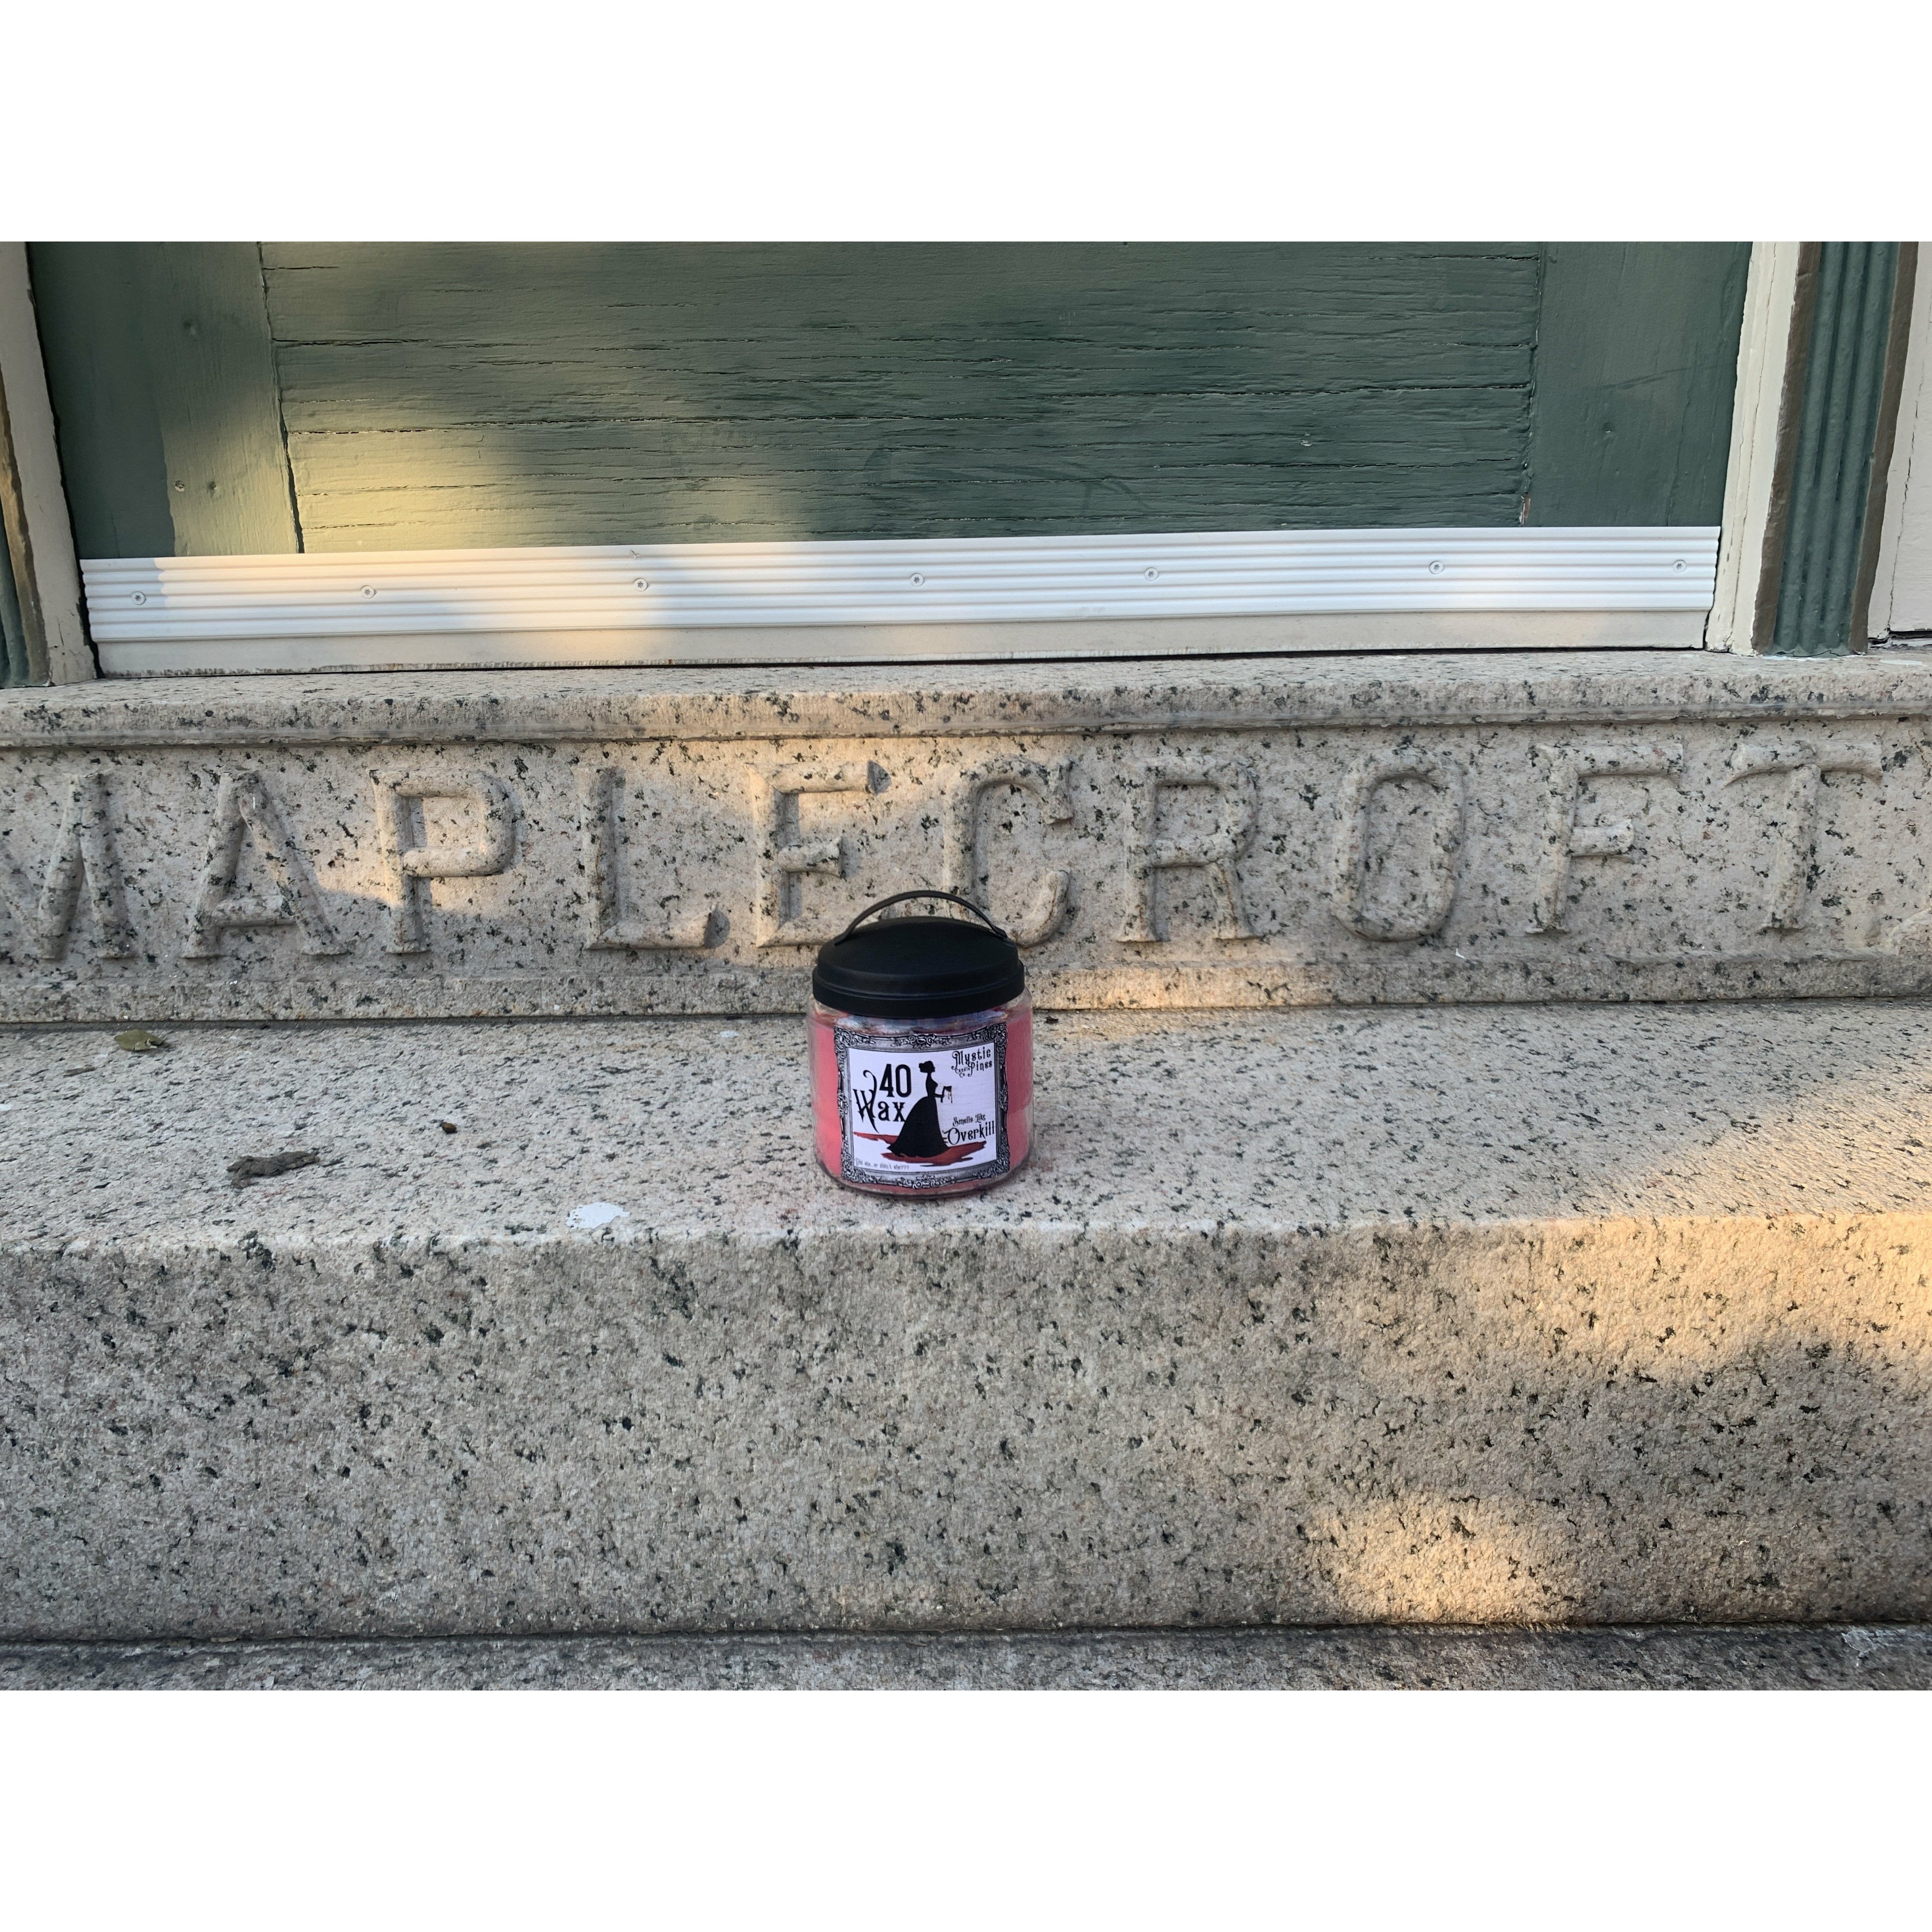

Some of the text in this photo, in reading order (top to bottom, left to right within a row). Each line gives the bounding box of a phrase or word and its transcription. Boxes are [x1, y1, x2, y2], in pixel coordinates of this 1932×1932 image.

[951, 1046, 991, 1070] Mystic
[967, 1060, 992, 1077] Pines
[879, 1063, 911, 1098] 40
[852, 1070, 907, 1134] Wax
[953, 1113, 986, 1127] Smells Like
[942, 1120, 995, 1145] Overkill
